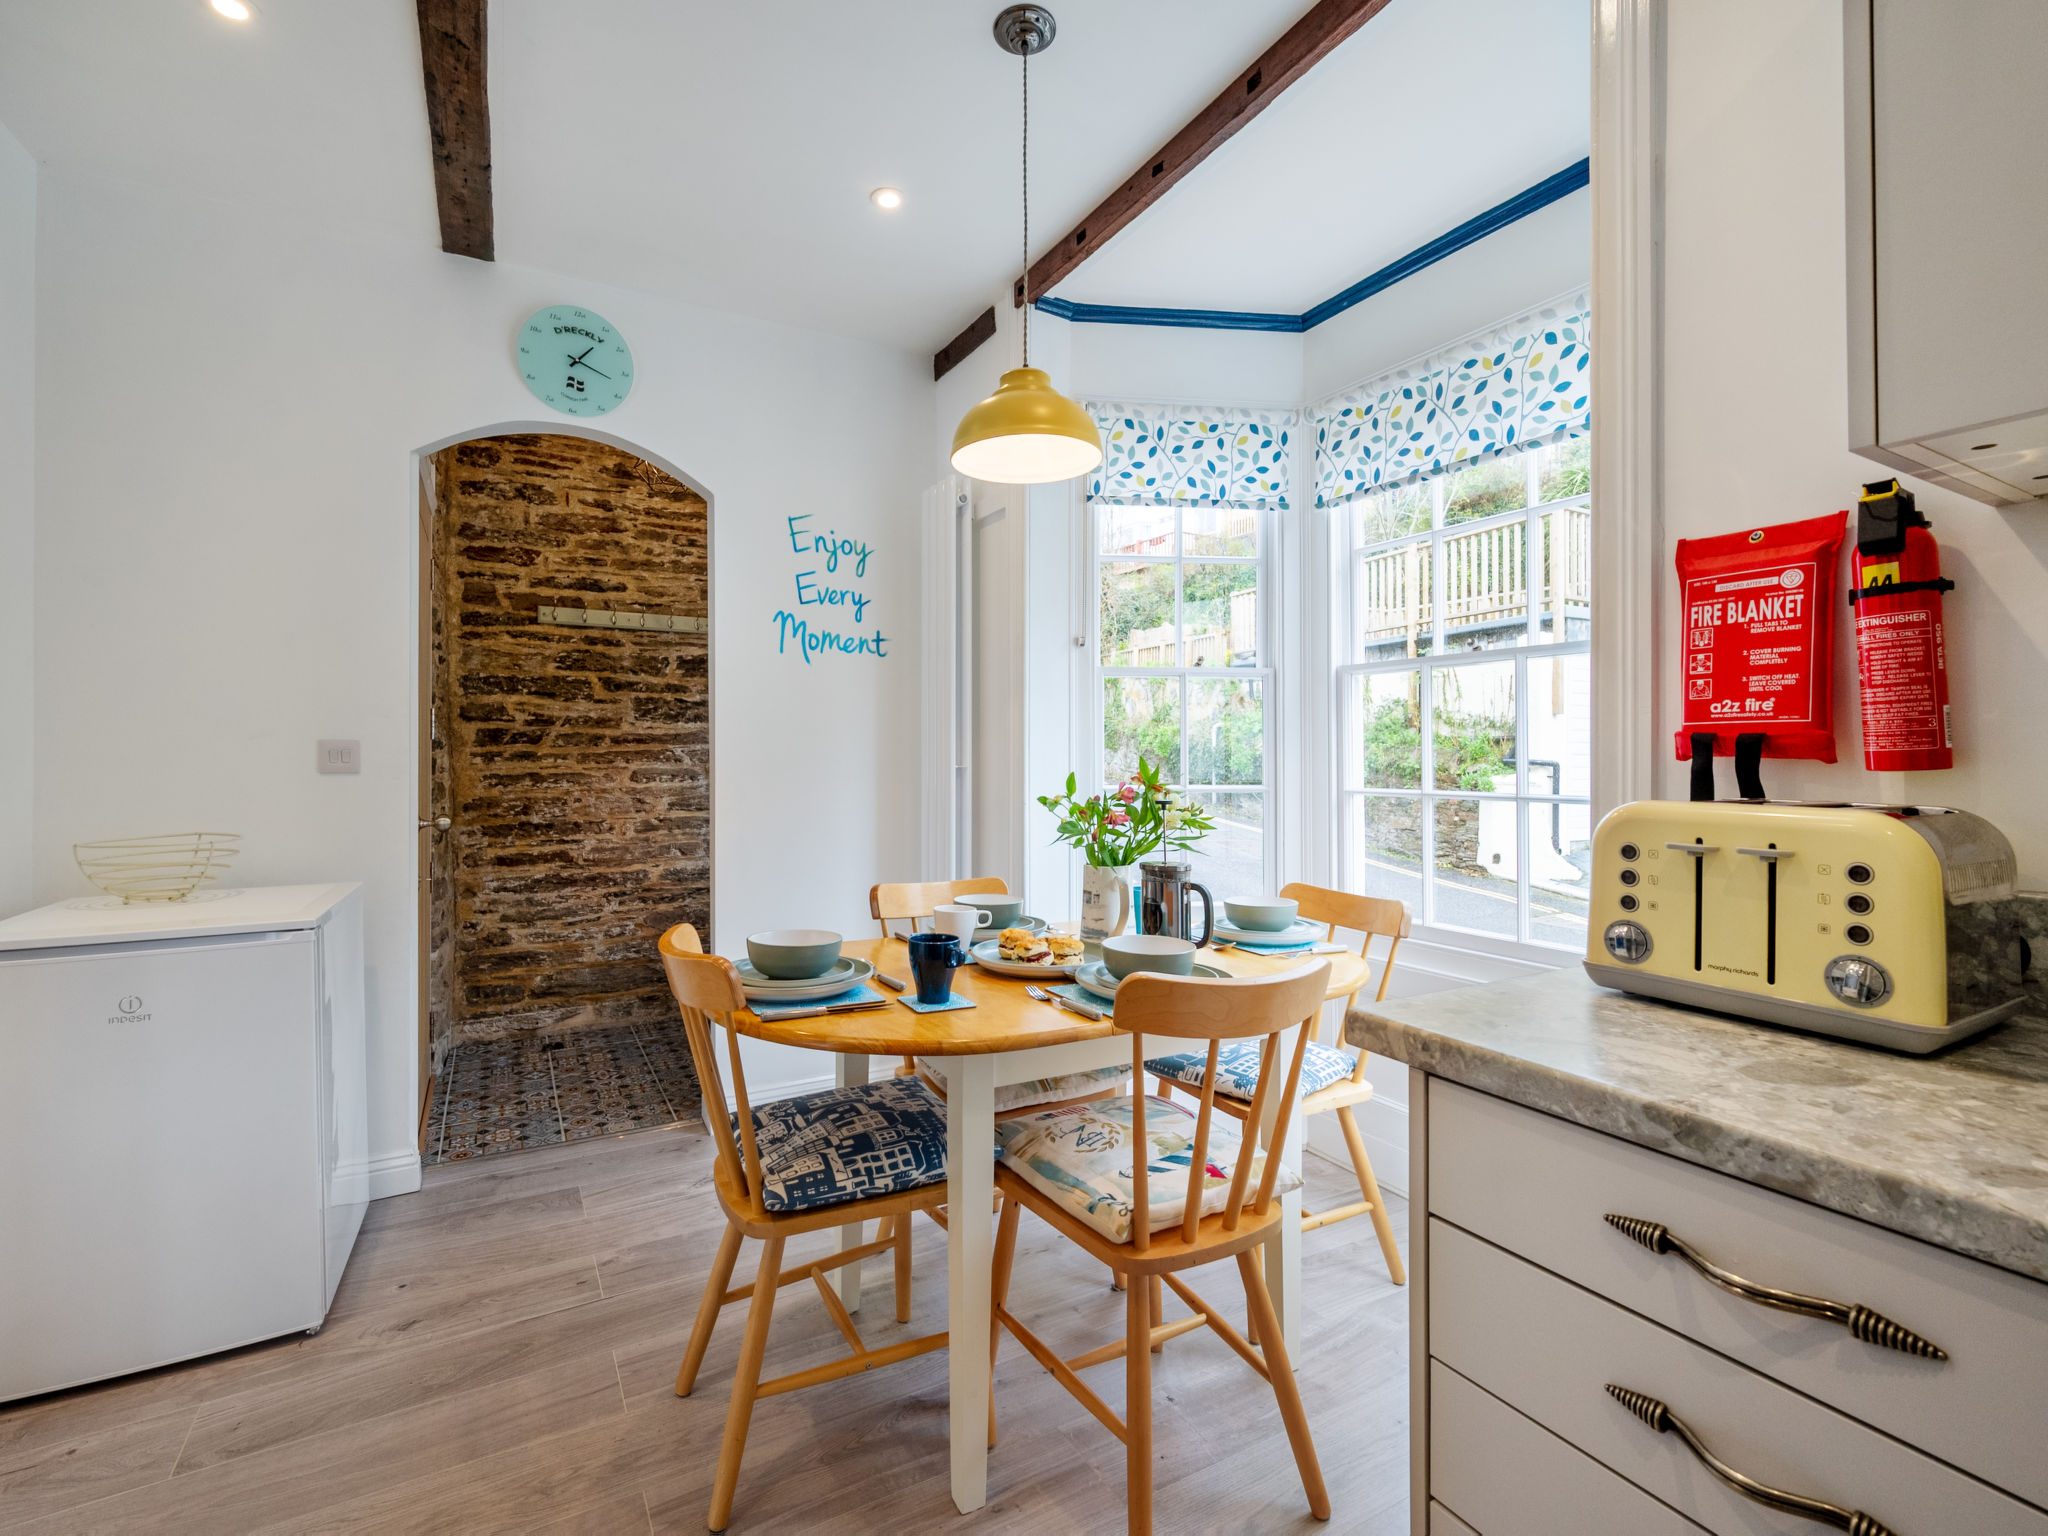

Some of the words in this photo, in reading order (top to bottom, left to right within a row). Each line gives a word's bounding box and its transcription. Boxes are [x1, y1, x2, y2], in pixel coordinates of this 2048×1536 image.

[554, 325, 605, 344] D'RECKLY
[788, 514, 875, 578] Enjoy
[795, 571, 872, 623] Every
[1690, 604, 1722, 628] FIRE
[1727, 594, 1804, 624] BLANKET
[1750, 626, 1775, 634] REMOVE
[1776, 623, 1802, 631] BLANKET
[1858, 613, 1927, 628] EXTINGUISHER
[772, 610, 892, 665] Moment
[1709, 699, 1741, 713] a2z
[1928, 718, 1936, 727] 3
[1708, 964, 1732, 973] morphy
[1732, 968, 1759, 977] richards
